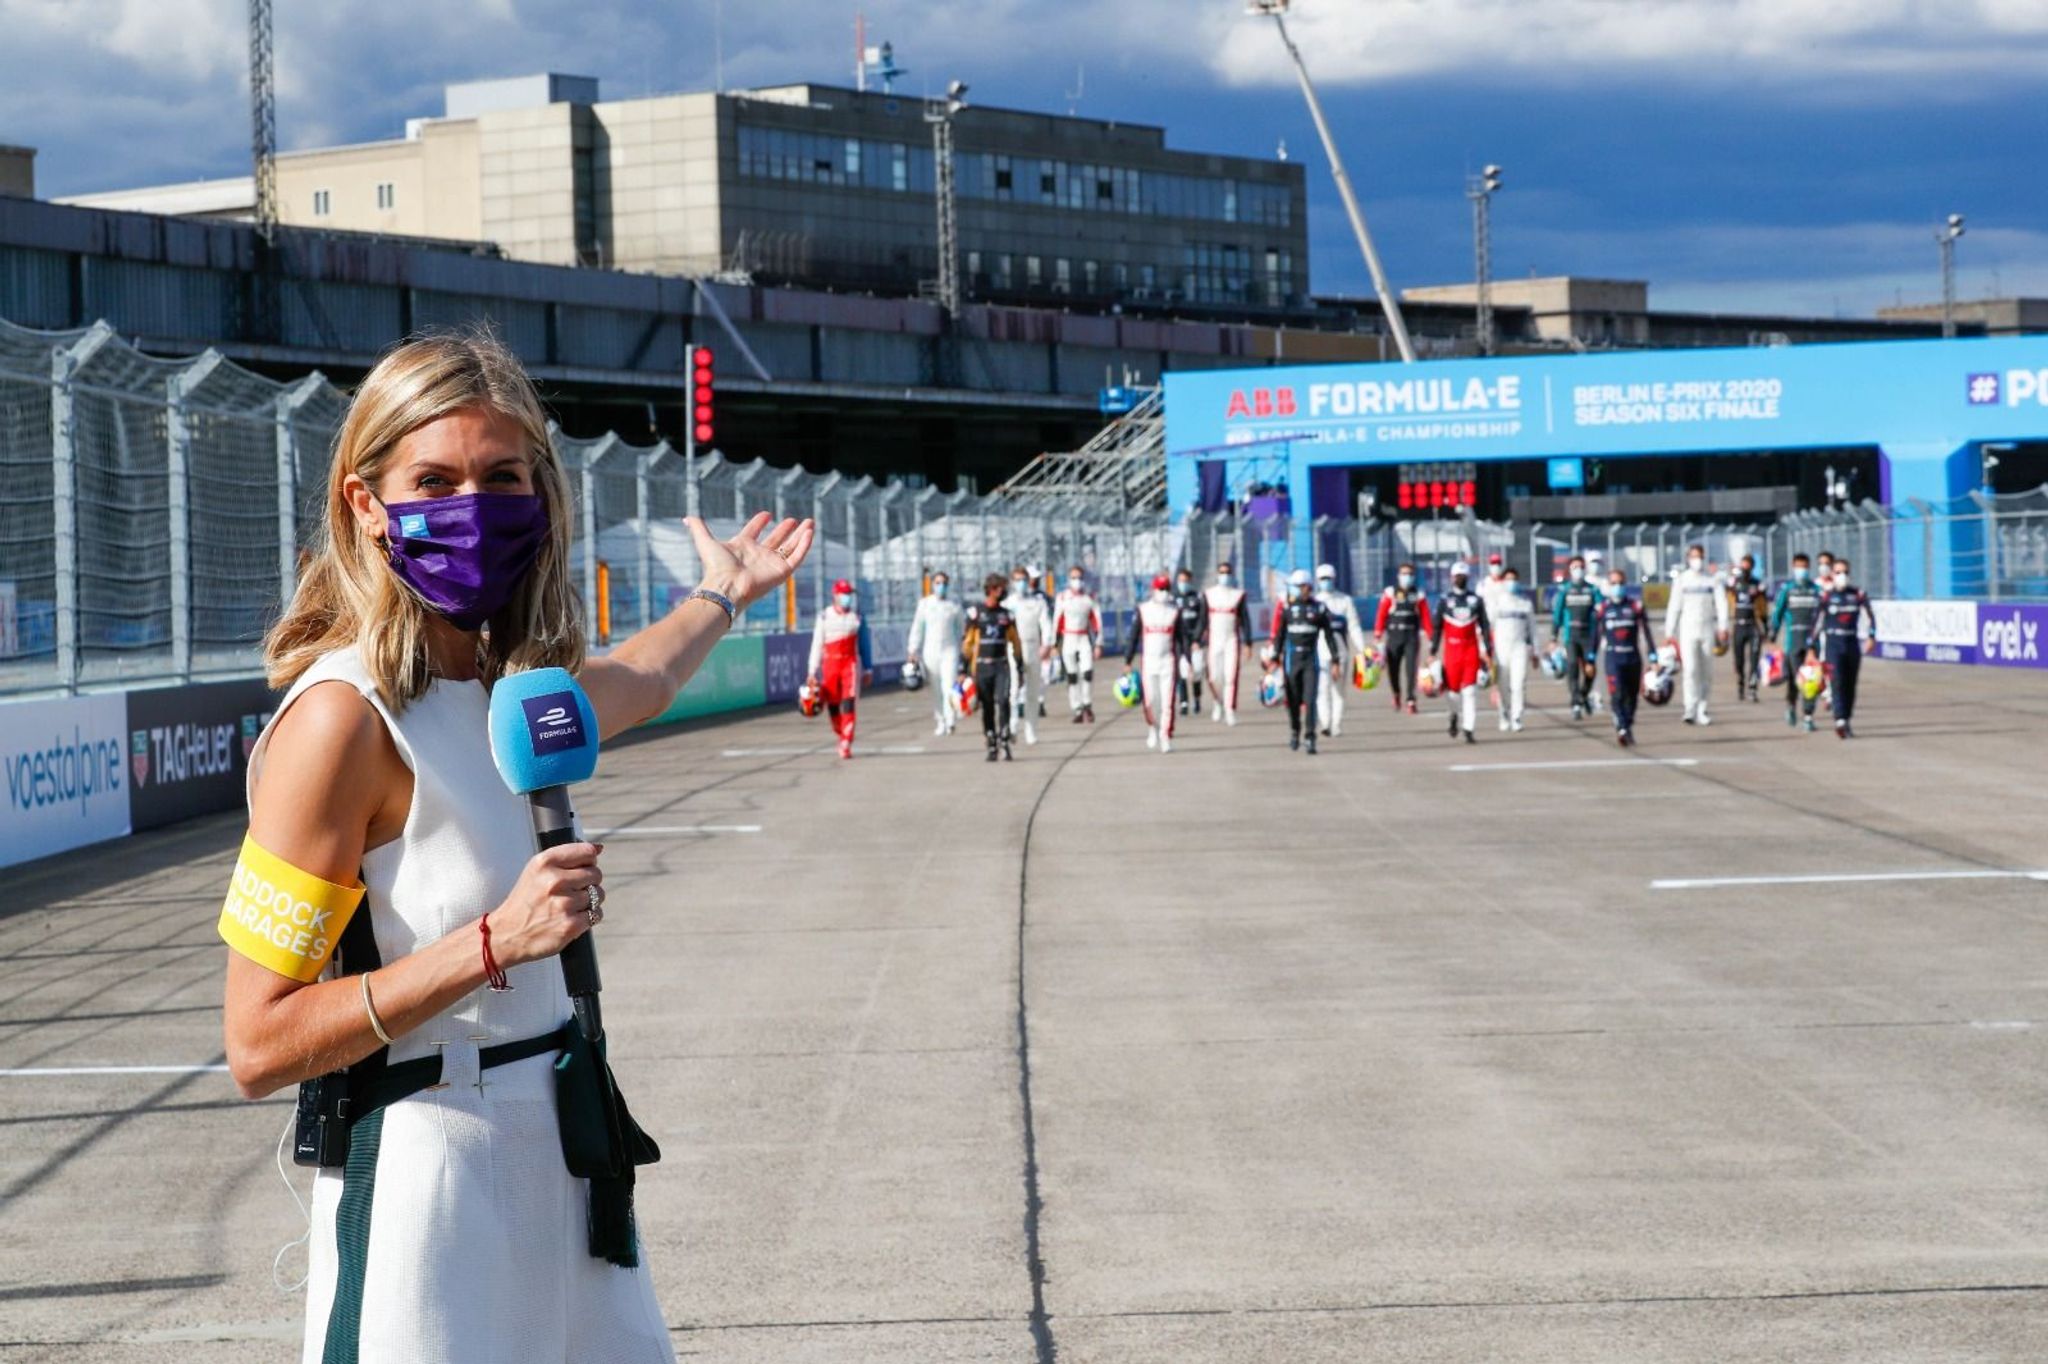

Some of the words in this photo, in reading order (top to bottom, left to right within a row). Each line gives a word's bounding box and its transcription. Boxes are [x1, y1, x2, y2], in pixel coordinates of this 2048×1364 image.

[1227, 387, 1296, 418] ABB
[1573, 384, 1649, 406] BERLIN
[1653, 381, 1724, 402] E-PRIX
[1726, 378, 1782, 399] 2020
[1575, 404, 1662, 426] SEASON
[1666, 402, 1703, 423] SIX
[1705, 398, 1780, 420] FINALE
[1377, 421, 1522, 442] CHAMPIONSHIP
[5, 725, 120, 818] voestalpine
